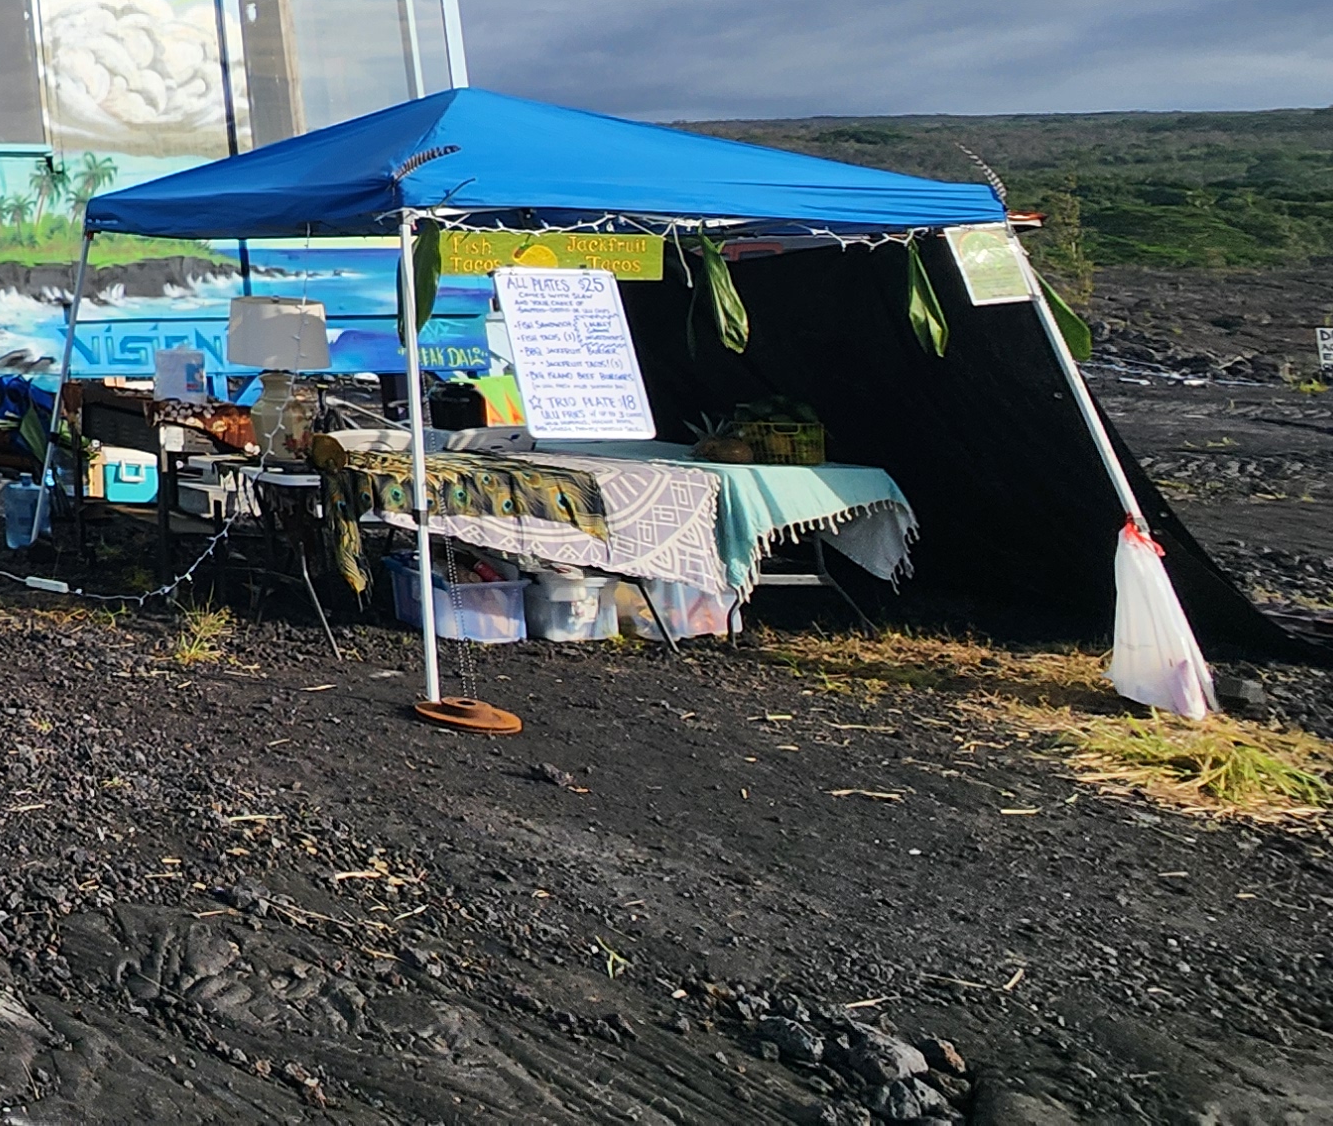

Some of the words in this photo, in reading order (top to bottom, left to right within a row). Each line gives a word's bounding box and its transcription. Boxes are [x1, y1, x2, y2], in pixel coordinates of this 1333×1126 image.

[451, 234, 493, 255] Fish
[566, 235, 647, 253] Jackfruit
[450, 256, 501, 272] Tacos
[586, 255, 642, 272] Tacos
[506, 276, 528, 290] ALL
[530, 277, 571, 292] PLATES
[578, 277, 605, 292] $25
[545, 396, 577, 409] TRIO
[582, 396, 617, 408] PLATE
